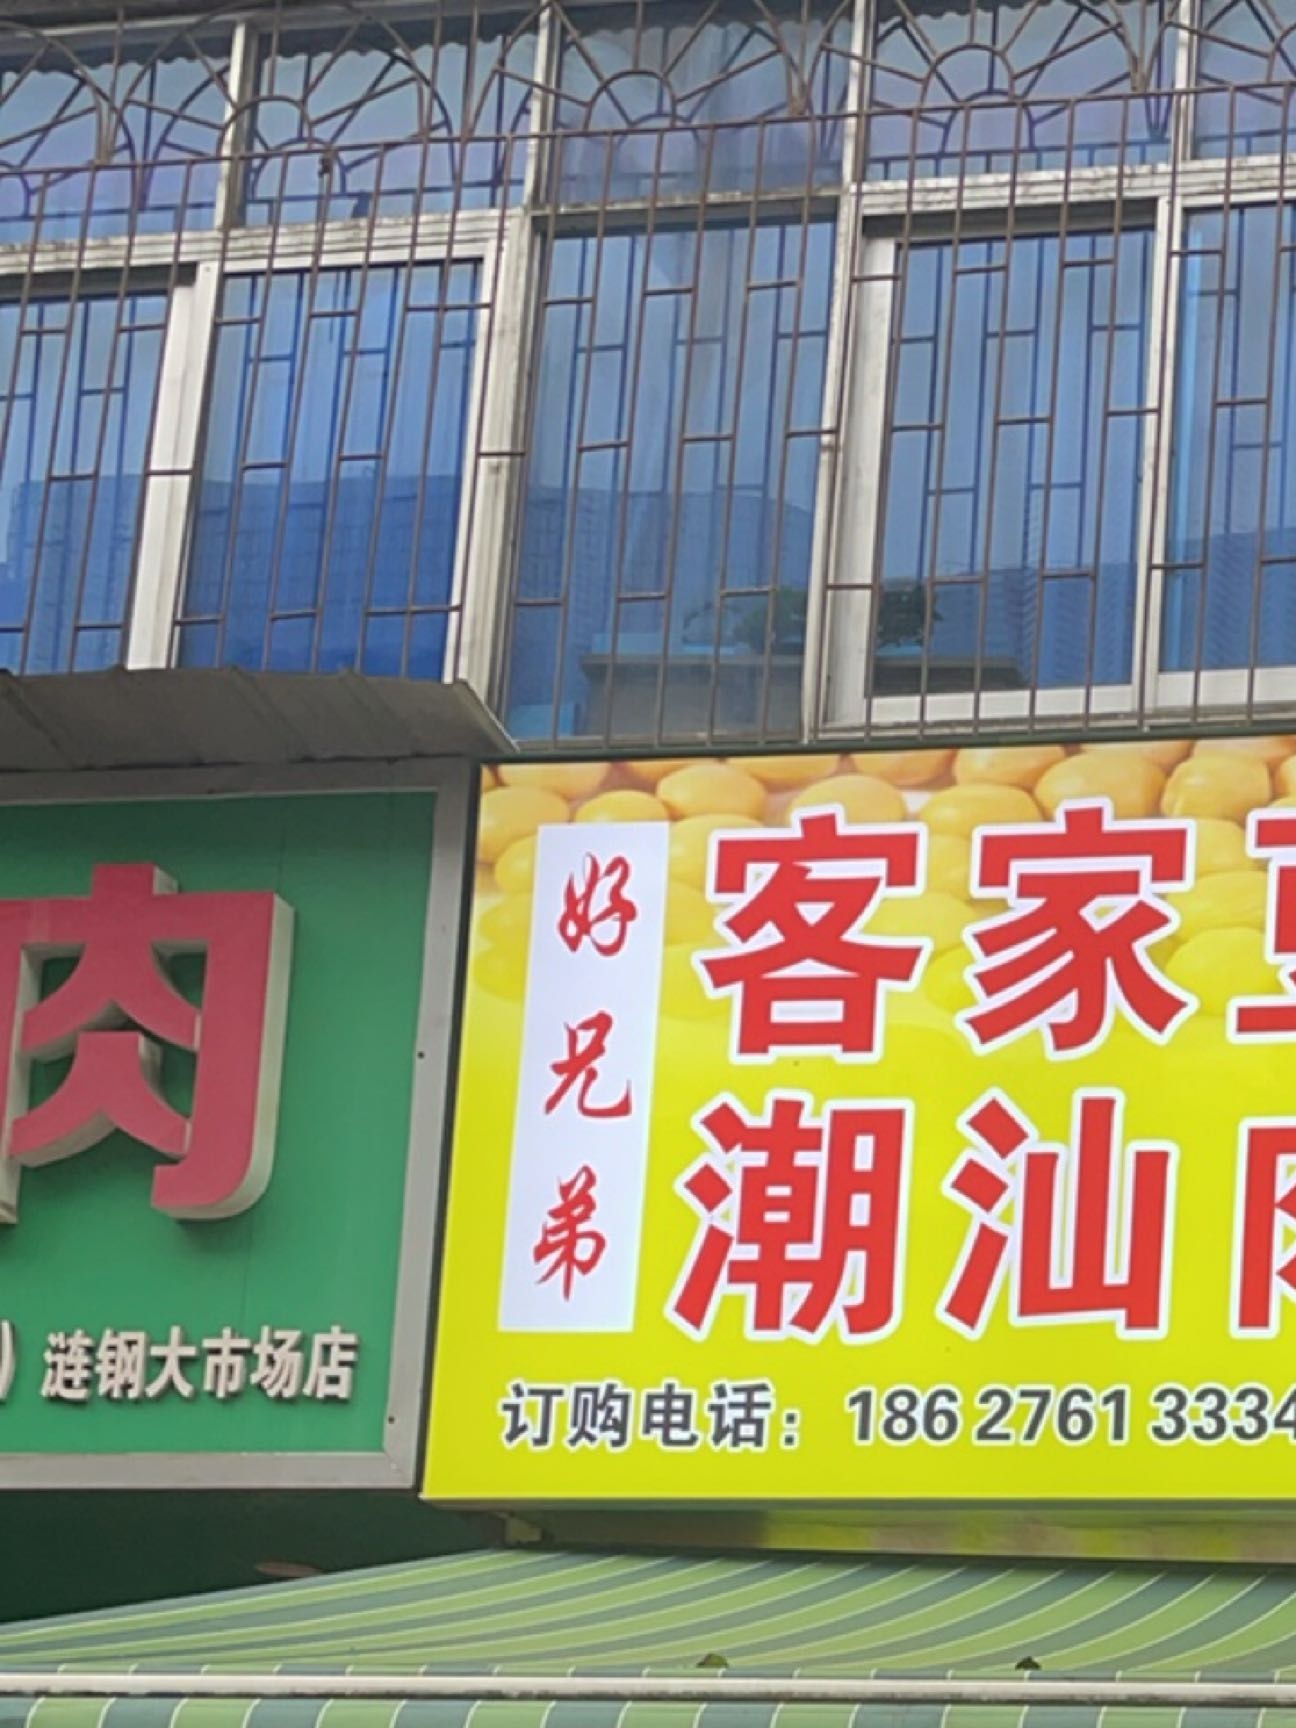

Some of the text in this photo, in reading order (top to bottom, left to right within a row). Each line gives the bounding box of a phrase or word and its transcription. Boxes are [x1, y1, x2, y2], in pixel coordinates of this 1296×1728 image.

[534, 852, 638, 1300] 好兄弟
[41, 1325, 359, 1402] 涟钢大市场店
[848, 1388, 959, 1442] 186
[976, 1388, 1127, 1442] 2761
